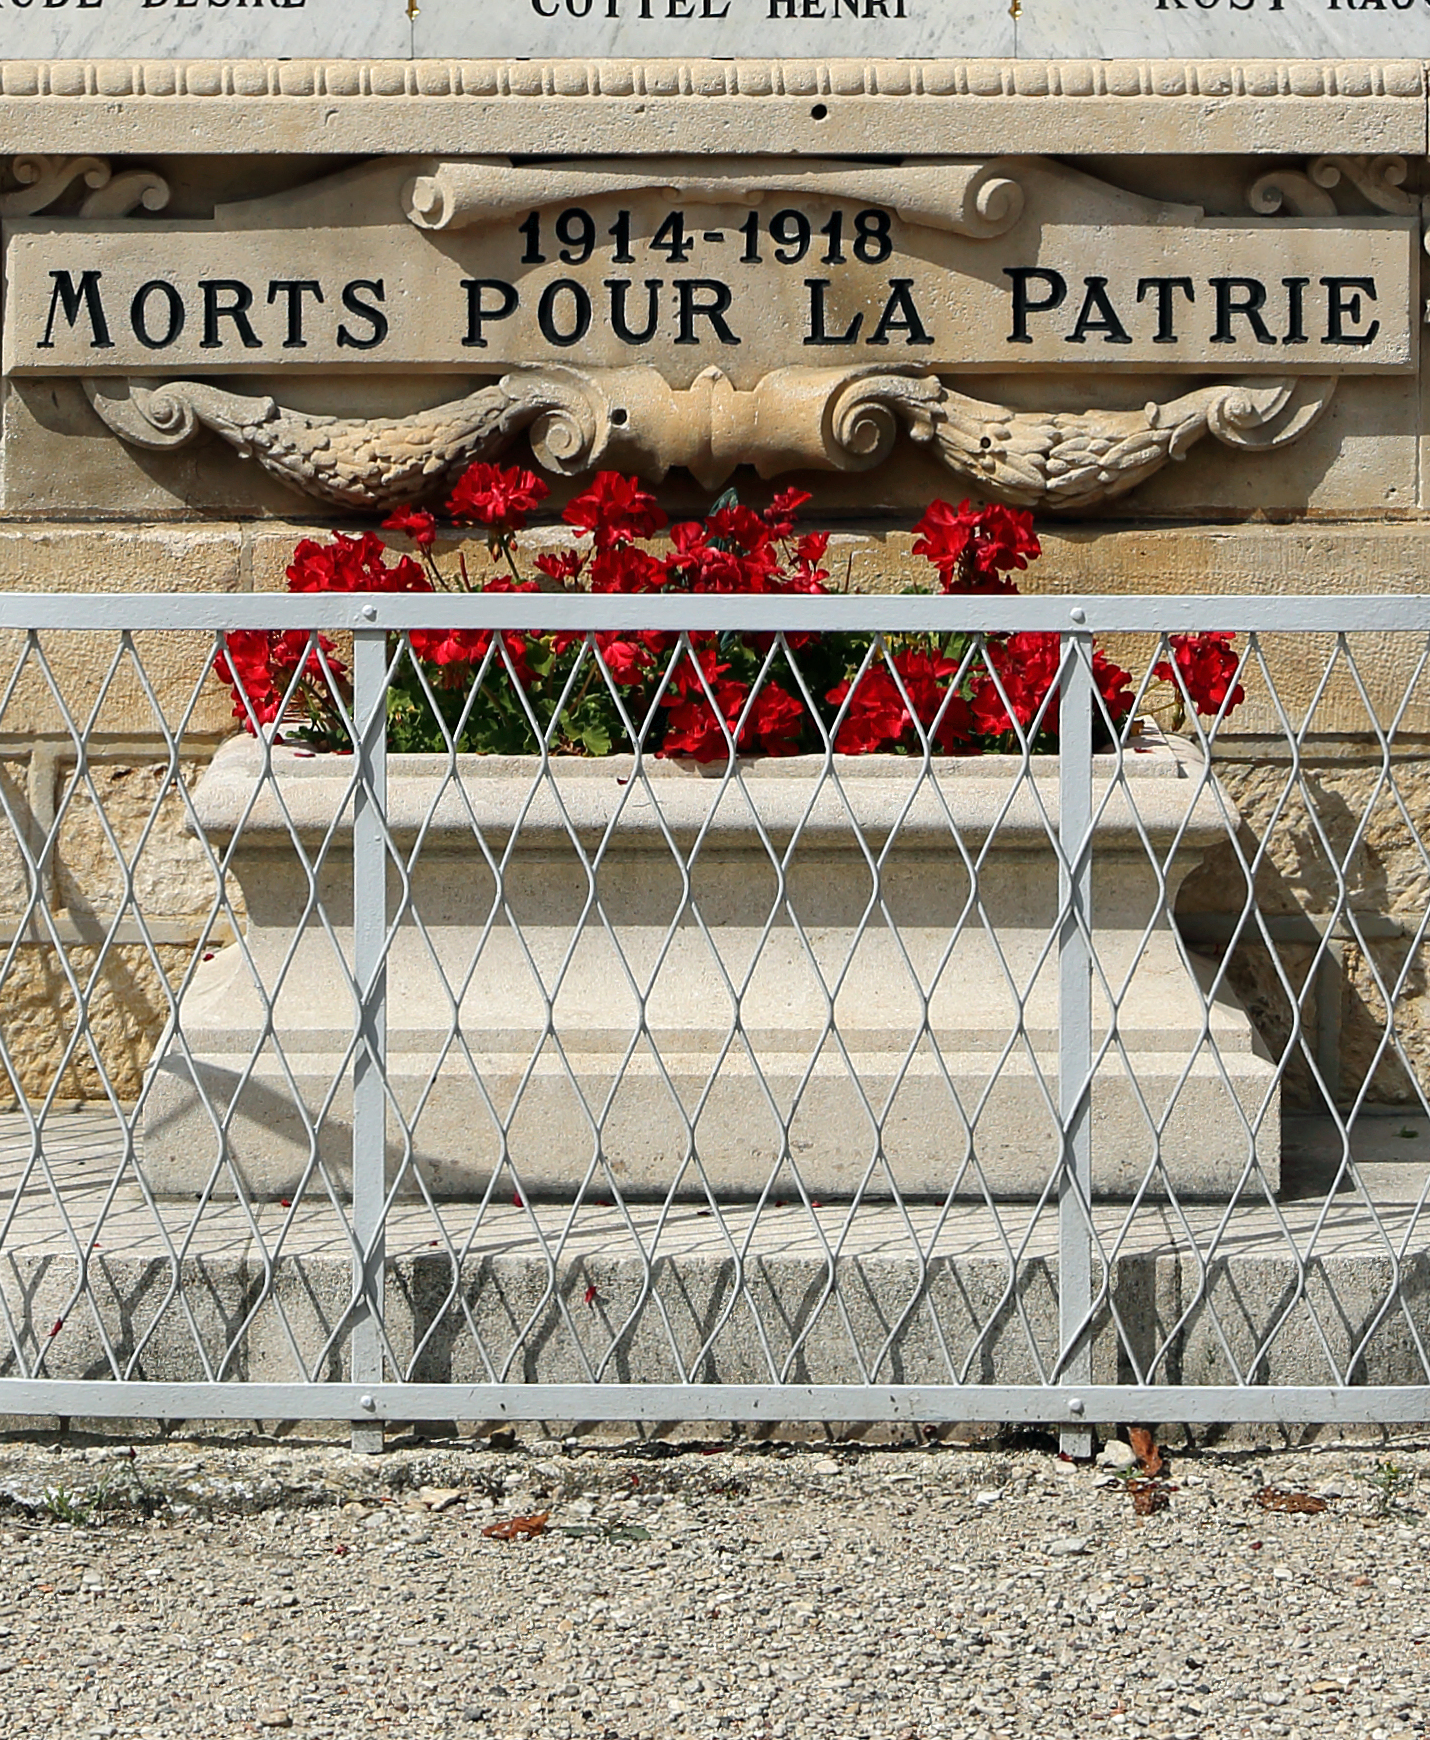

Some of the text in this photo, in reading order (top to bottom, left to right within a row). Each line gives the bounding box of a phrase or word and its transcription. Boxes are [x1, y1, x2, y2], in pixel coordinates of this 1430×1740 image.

[518, 207, 895, 265] 1914-1918
[36, 267, 1381, 351] MORTS POUR LA PATRIE
